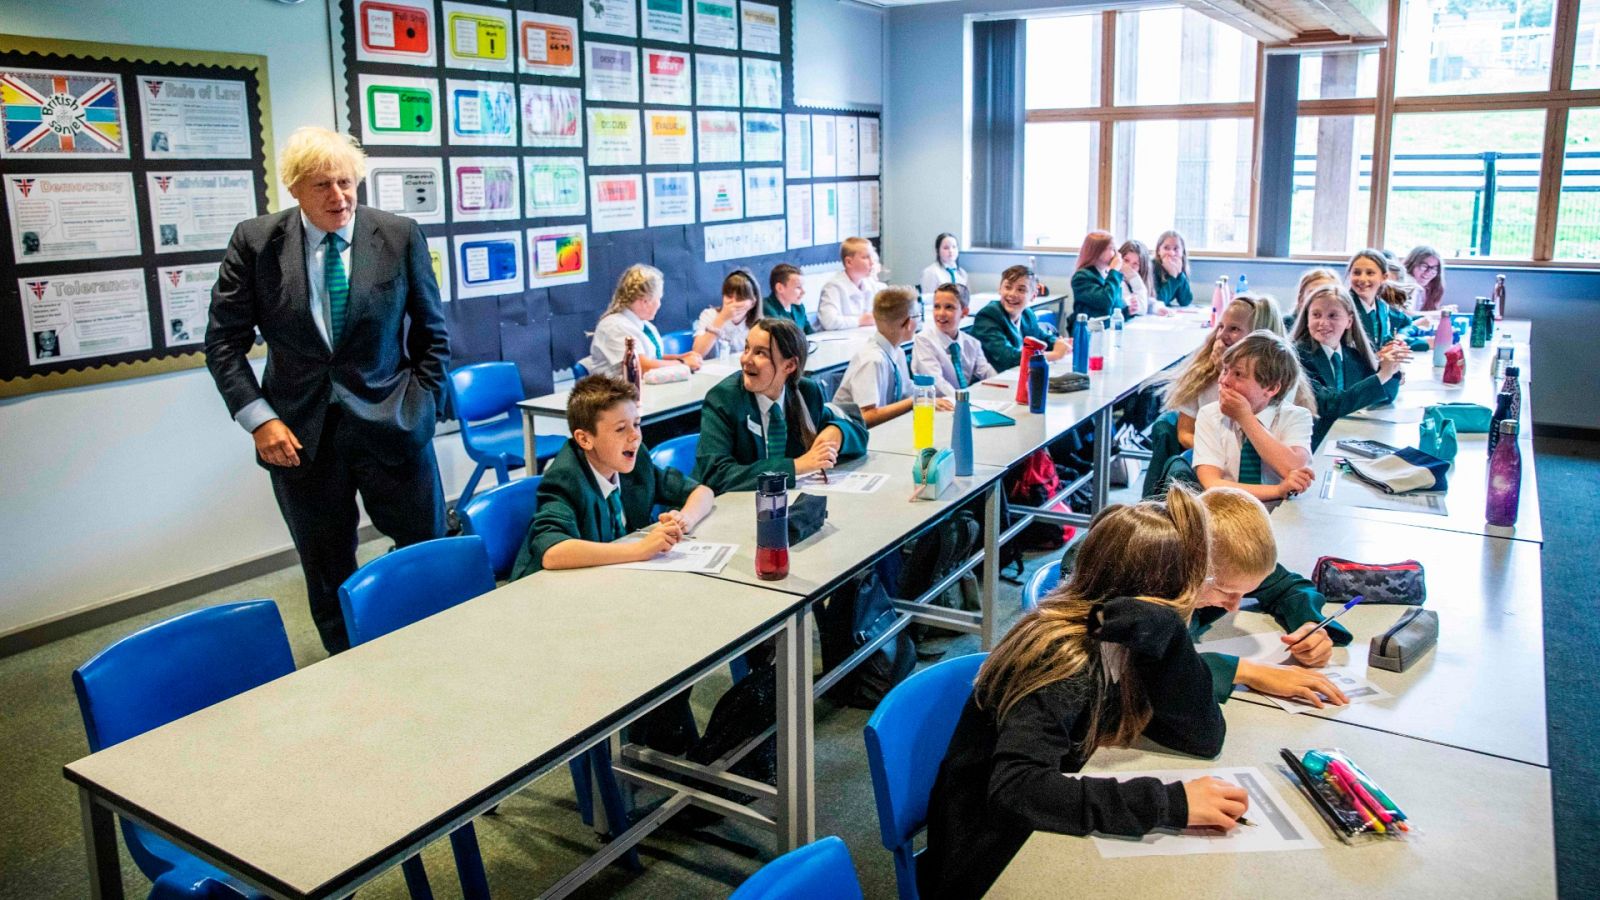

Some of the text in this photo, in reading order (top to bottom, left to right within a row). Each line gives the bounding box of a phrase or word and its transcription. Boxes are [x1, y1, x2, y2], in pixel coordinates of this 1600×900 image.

[198, 85, 212, 99] of
[401, 94, 430, 104] Comma
[42, 93, 79, 115] British
[48, 113, 85, 136] Values
[40, 180, 123, 194] Democracy
[51, 278, 140, 297] Tolerance
